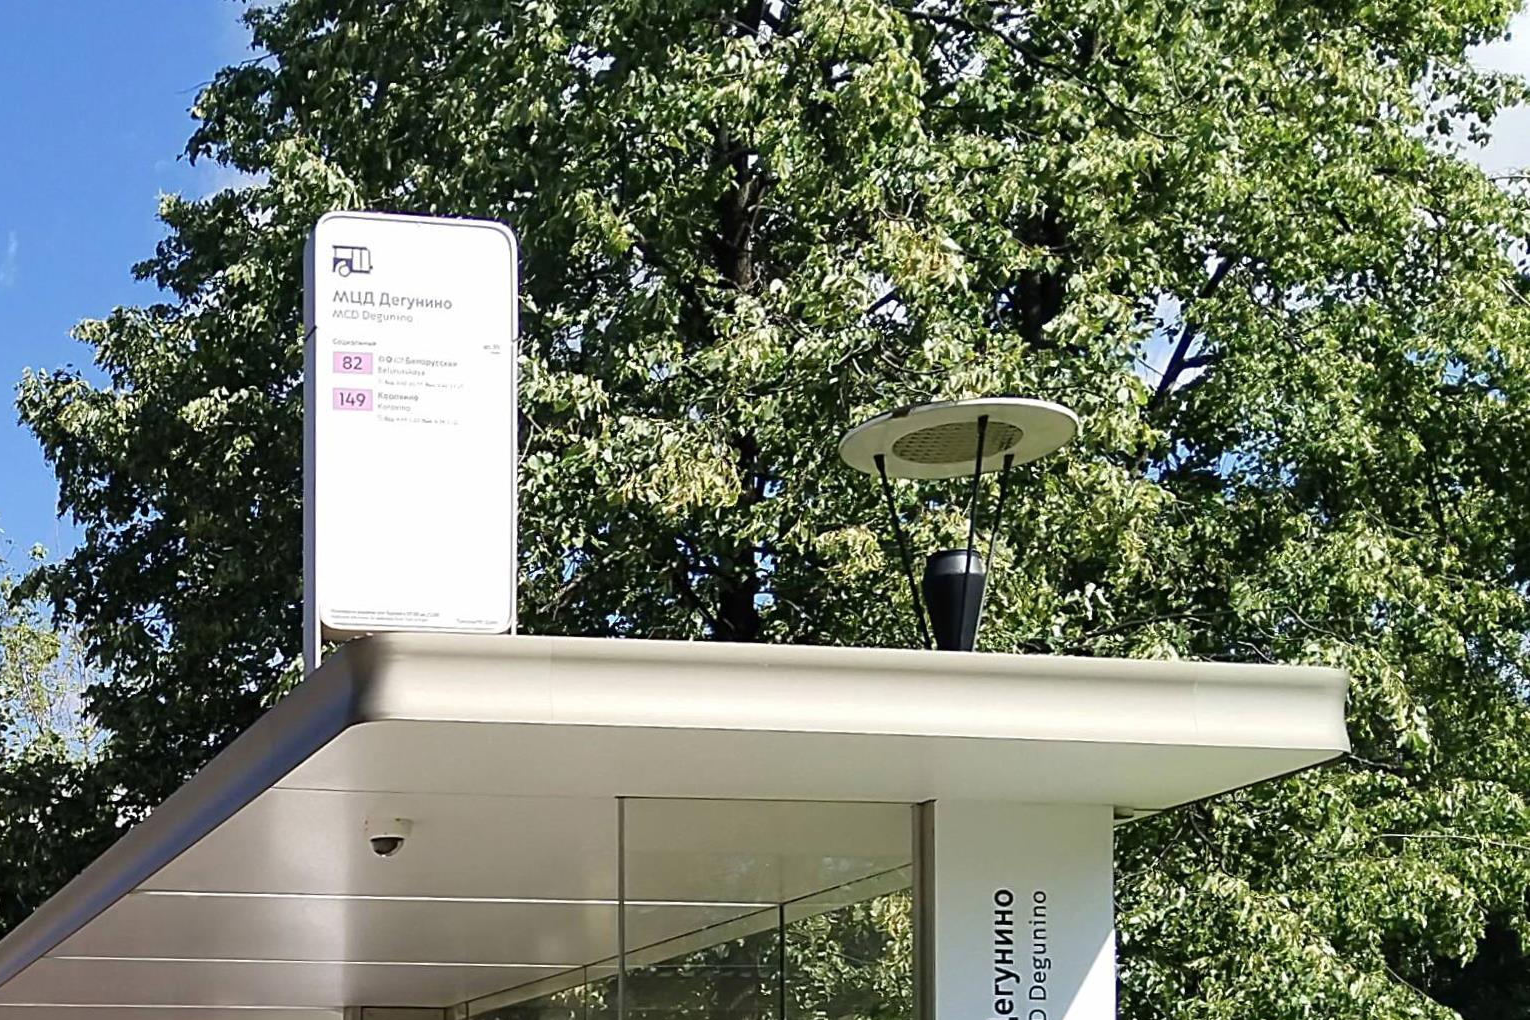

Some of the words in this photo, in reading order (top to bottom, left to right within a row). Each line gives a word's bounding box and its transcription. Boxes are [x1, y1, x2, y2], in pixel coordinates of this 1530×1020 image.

[333, 290, 375, 307] МЦД
[379, 291, 453, 310] Дегунино
[332, 309, 360, 320] MCD
[362, 311, 414, 323] Degunino
[342, 356, 363, 370] 82
[339, 392, 366, 407] 149
[1029, 890, 1051, 1001] Degunino
